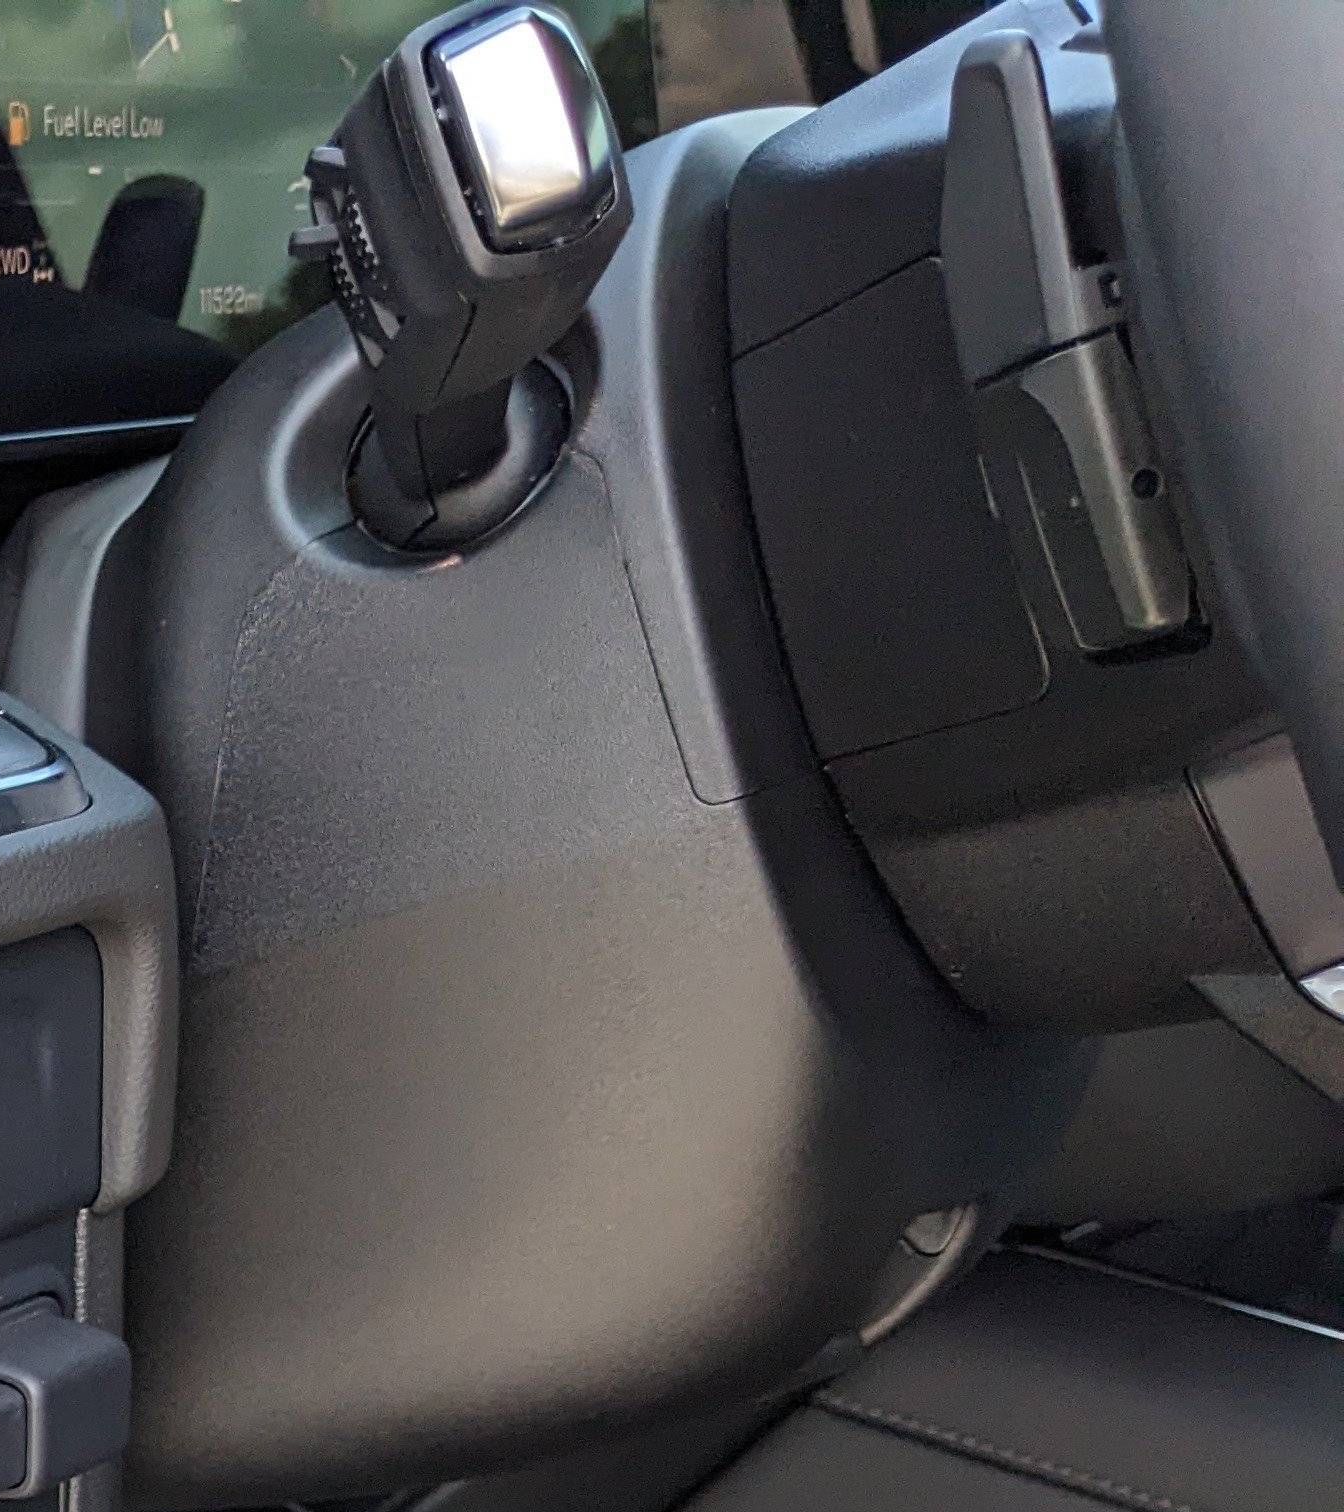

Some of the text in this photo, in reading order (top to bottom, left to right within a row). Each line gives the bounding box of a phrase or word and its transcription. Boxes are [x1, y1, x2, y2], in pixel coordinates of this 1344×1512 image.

[43, 105, 165, 139] Fuel Level Low
